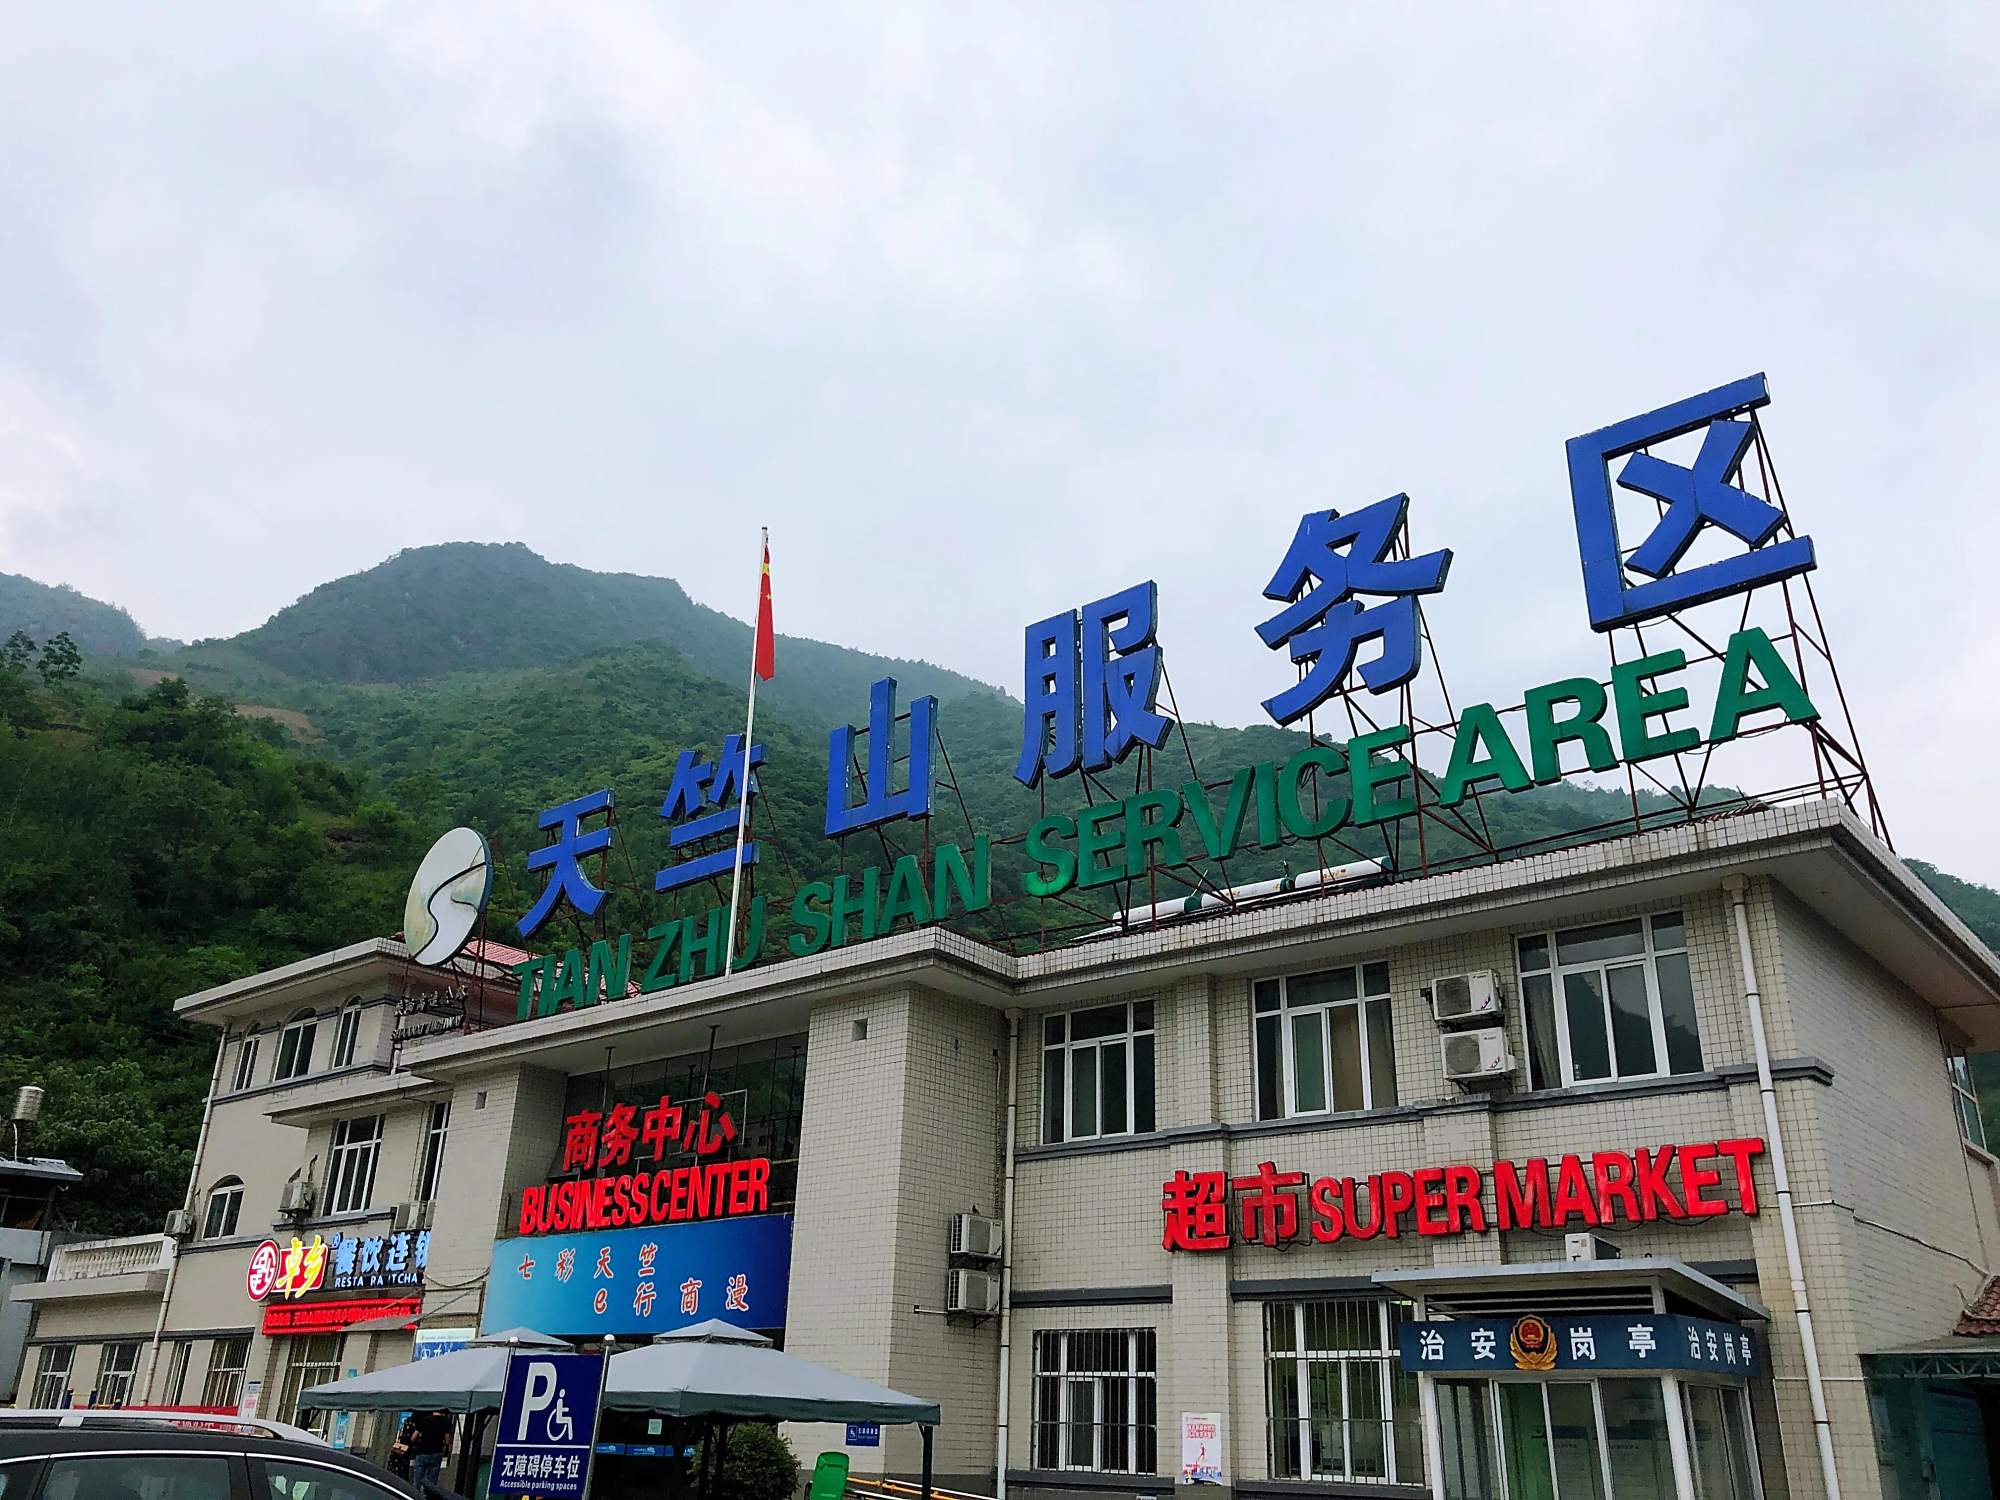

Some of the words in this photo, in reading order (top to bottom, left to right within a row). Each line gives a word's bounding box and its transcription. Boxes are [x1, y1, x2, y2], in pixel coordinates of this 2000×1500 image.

[516, 371, 1818, 940] 天竺山服务区
[513, 934, 631, 1022] TIAN
[641, 896, 766, 993] ZHU
[789, 833, 993, 957] SHAN
[1022, 724, 1418, 898] SERVICE
[1439, 626, 1821, 808] AREA
[561, 1091, 737, 1173] 商务中心
[1161, 1160, 1305, 1253] 超市
[1309, 1164, 1488, 1244] SUPER
[1494, 1137, 1767, 1231] MARKET
[518, 1242, 658, 1281] 七彩天竺
[1420, 1324, 1657, 1361] 治安岗亭
[1687, 1326, 1752, 1366] 治安岗亭
[517, 1362, 557, 1441] P
[499, 1479, 531, 1489] Accessible
[531, 1480, 555, 1492] parking
[555, 1483, 577, 1491] spaces
[501, 1454, 580, 1480] 无障碍停车位
